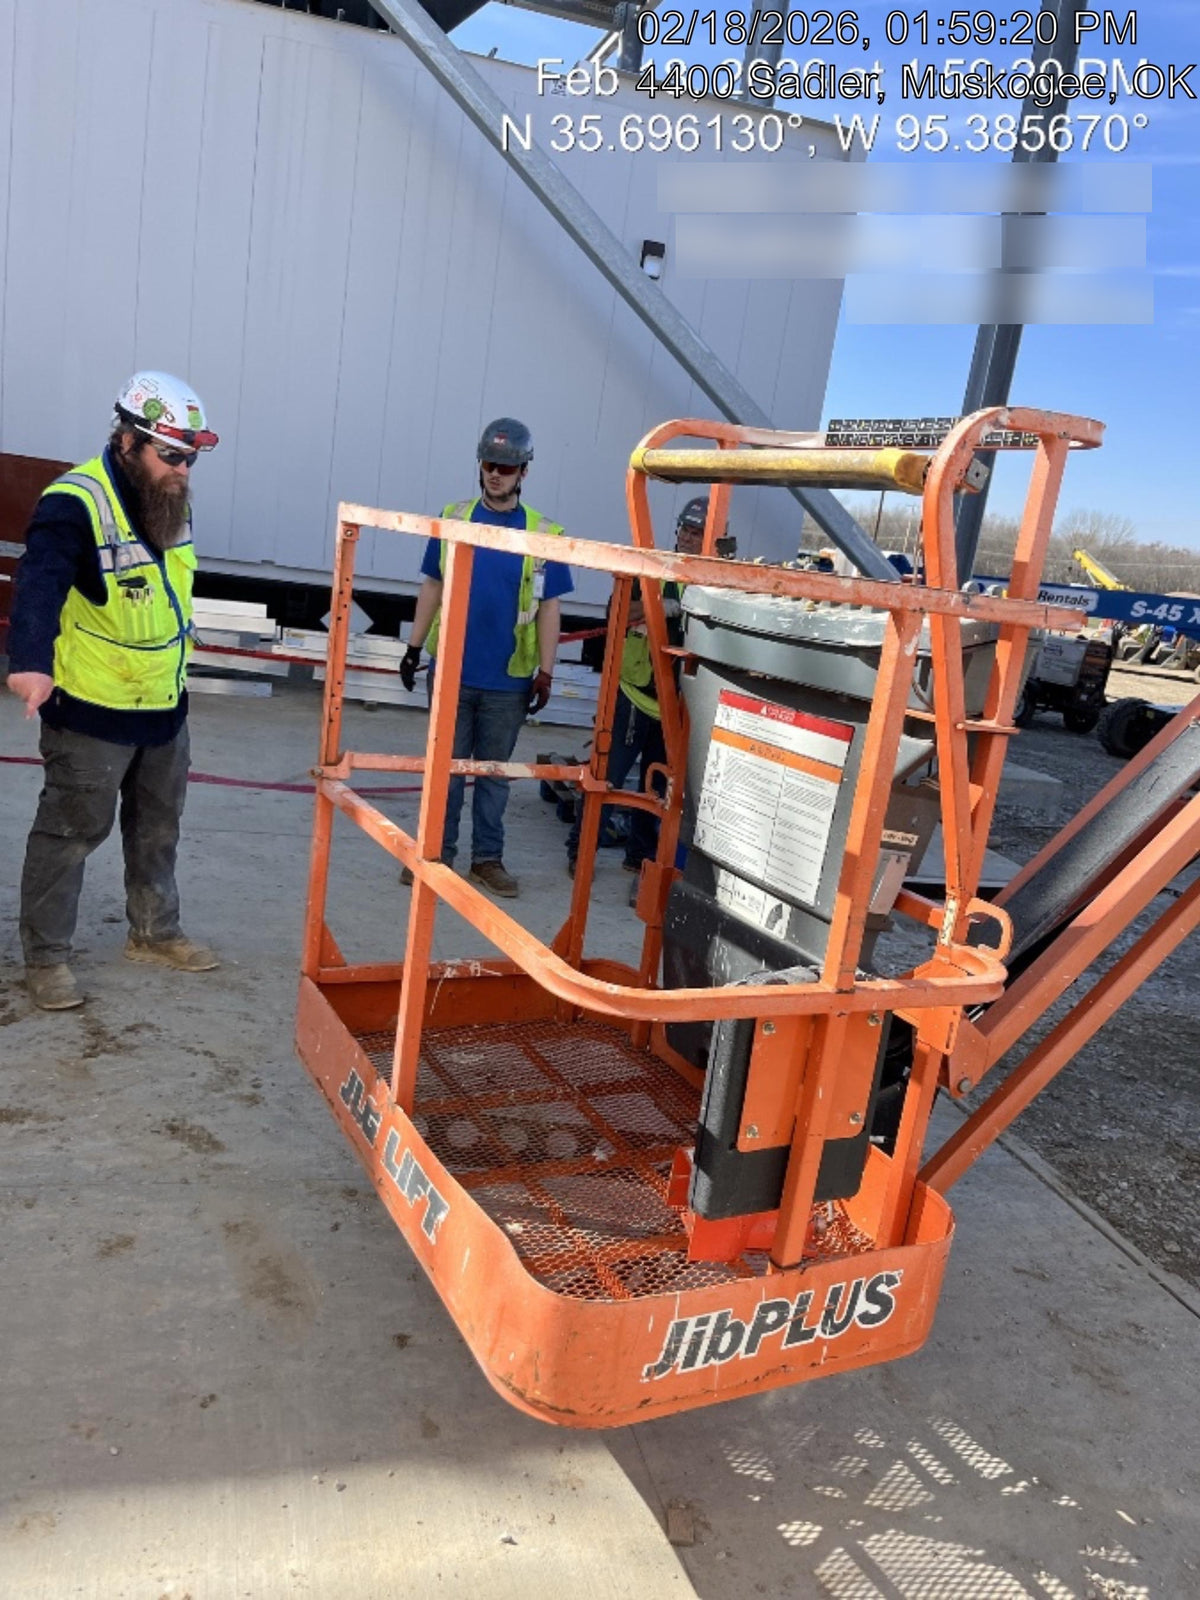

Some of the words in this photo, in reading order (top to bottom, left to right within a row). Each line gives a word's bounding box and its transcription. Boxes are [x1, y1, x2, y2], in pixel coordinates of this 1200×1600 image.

[1037, 589, 1090, 607] Rentals
[1130, 600, 1185, 622] S-45
[380, 1125, 450, 1246] LIFT
[639, 1269, 904, 1382] JibPLUS
